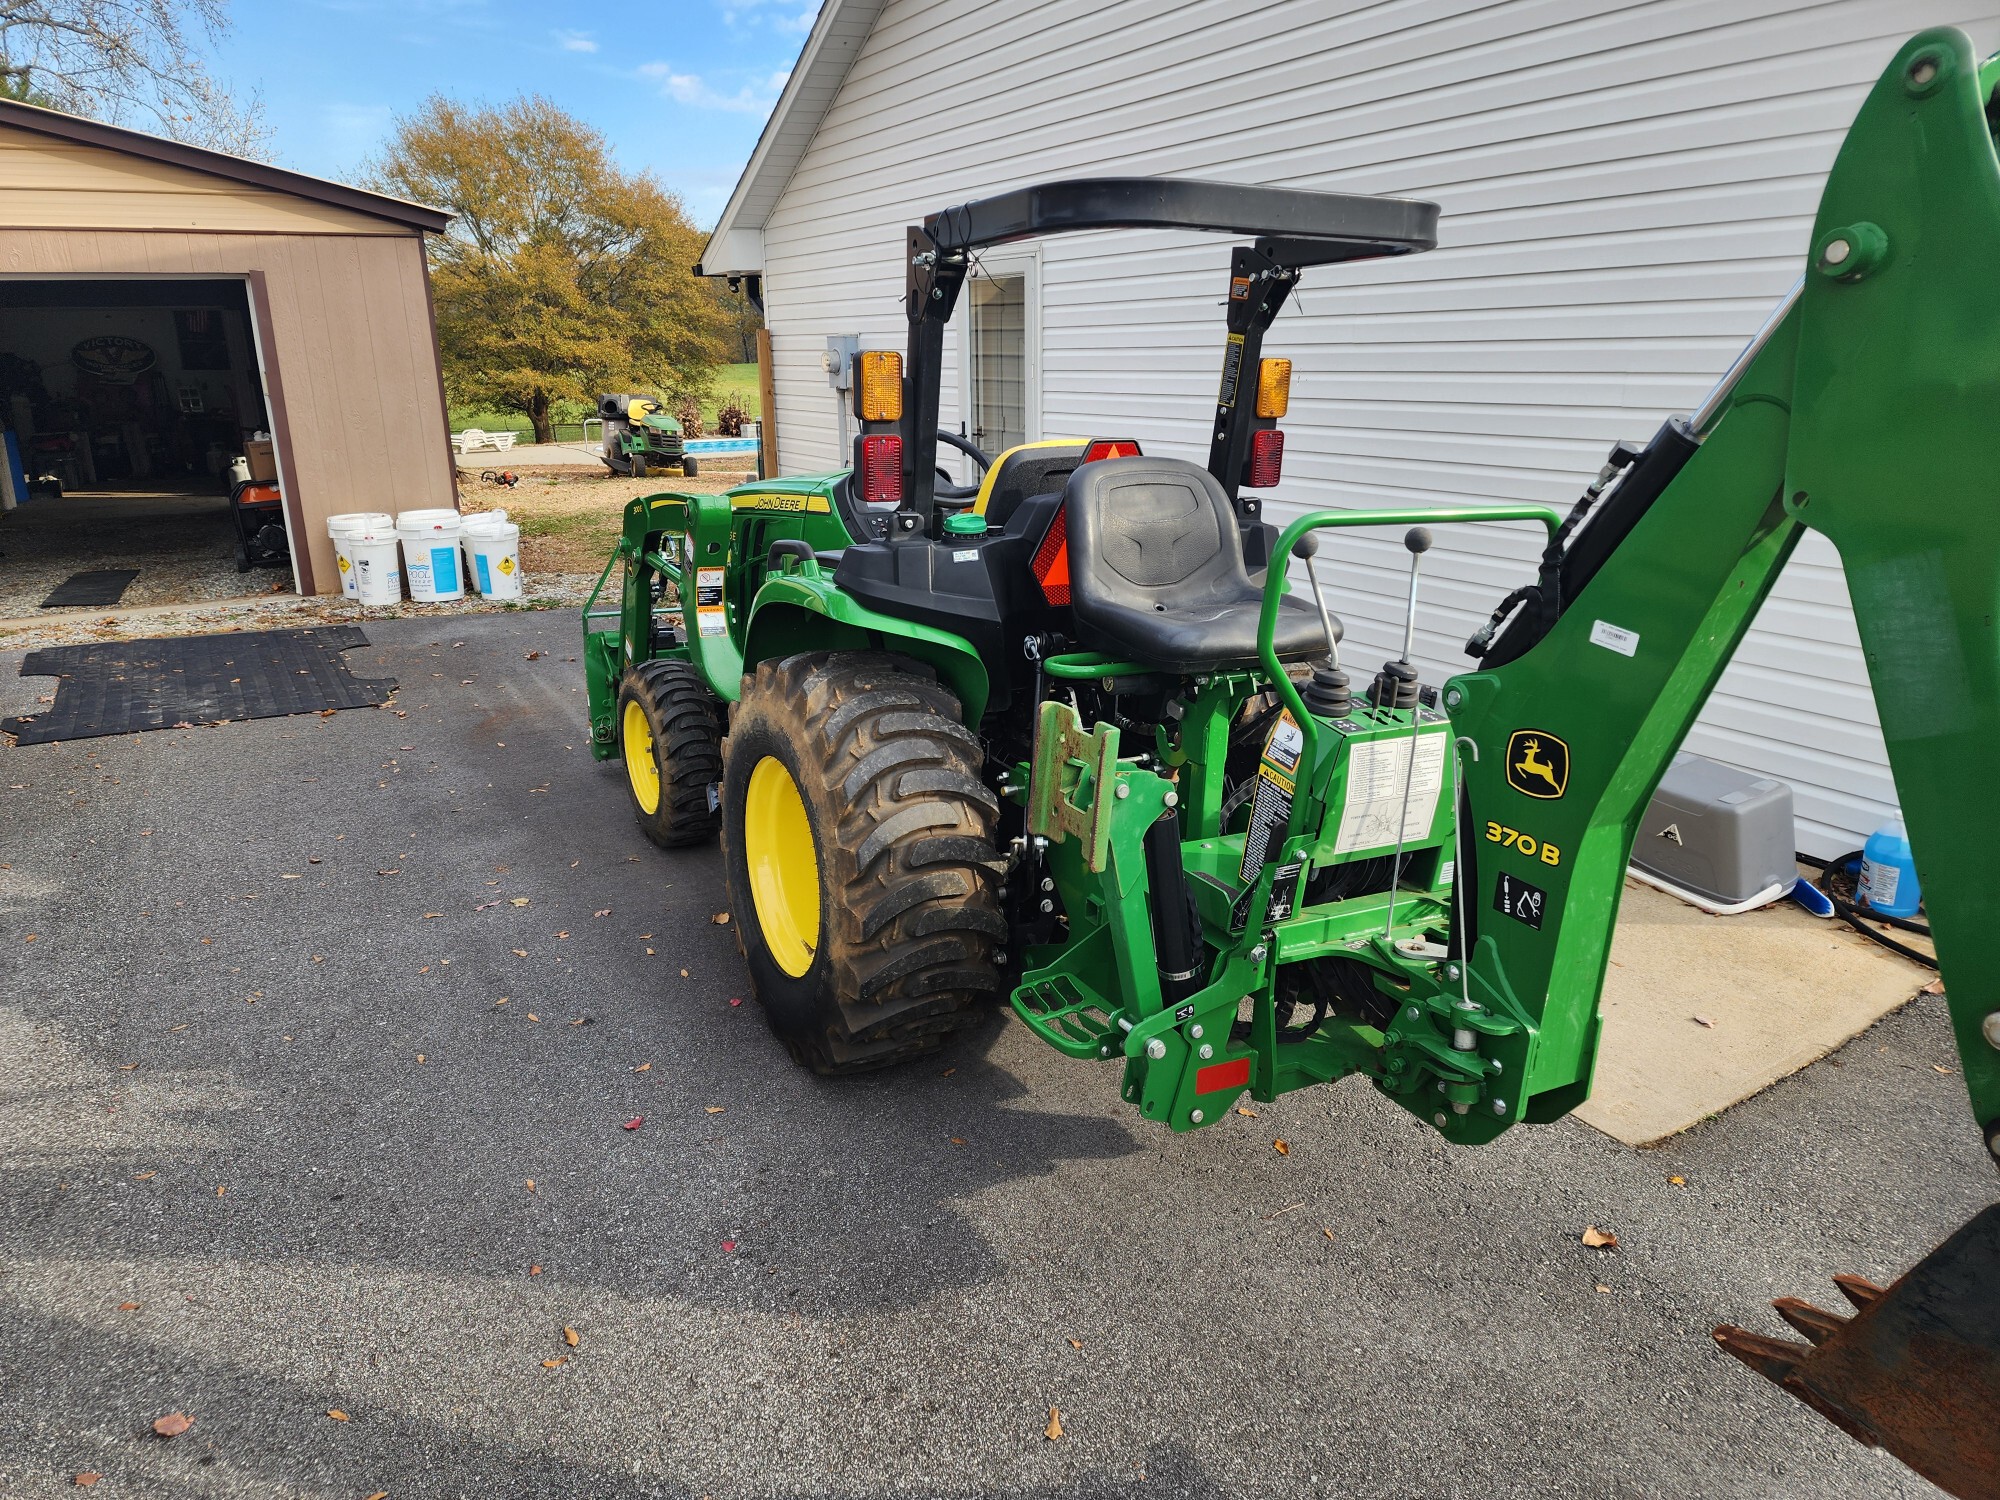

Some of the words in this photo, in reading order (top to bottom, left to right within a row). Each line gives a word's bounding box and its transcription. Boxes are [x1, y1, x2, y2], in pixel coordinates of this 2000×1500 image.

[83, 336, 143, 351] VICTORY
[754, 496, 774, 509] JOHN
[774, 496, 801, 510] DEERE
[1268, 772, 1295, 793] CAUTION
[1485, 821, 1537, 857] 370
[1540, 841, 1561, 867] B
